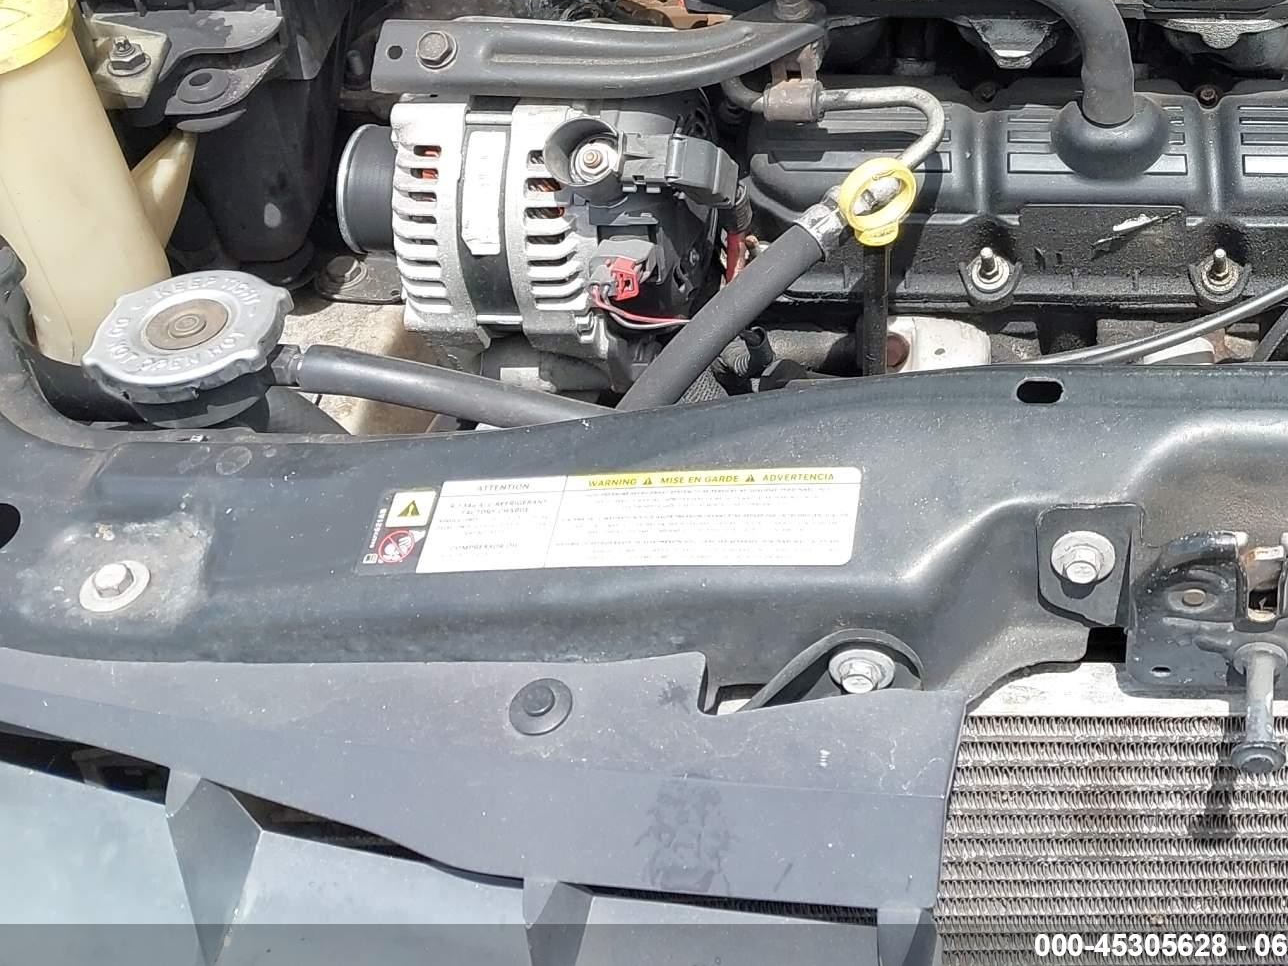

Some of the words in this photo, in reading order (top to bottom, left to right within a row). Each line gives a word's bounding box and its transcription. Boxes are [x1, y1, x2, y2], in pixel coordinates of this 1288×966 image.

[154, 275, 219, 299] KEEP
[139, 351, 201, 373] OPEN
[477, 483, 530, 492] ATTENTION
[587, 477, 637, 488] WARNING
[660, 475, 687, 485] MISE
[688, 475, 704, 484] EN
[704, 474, 739, 484] GARDE
[762, 472, 835, 482] ADVERTENCIA
